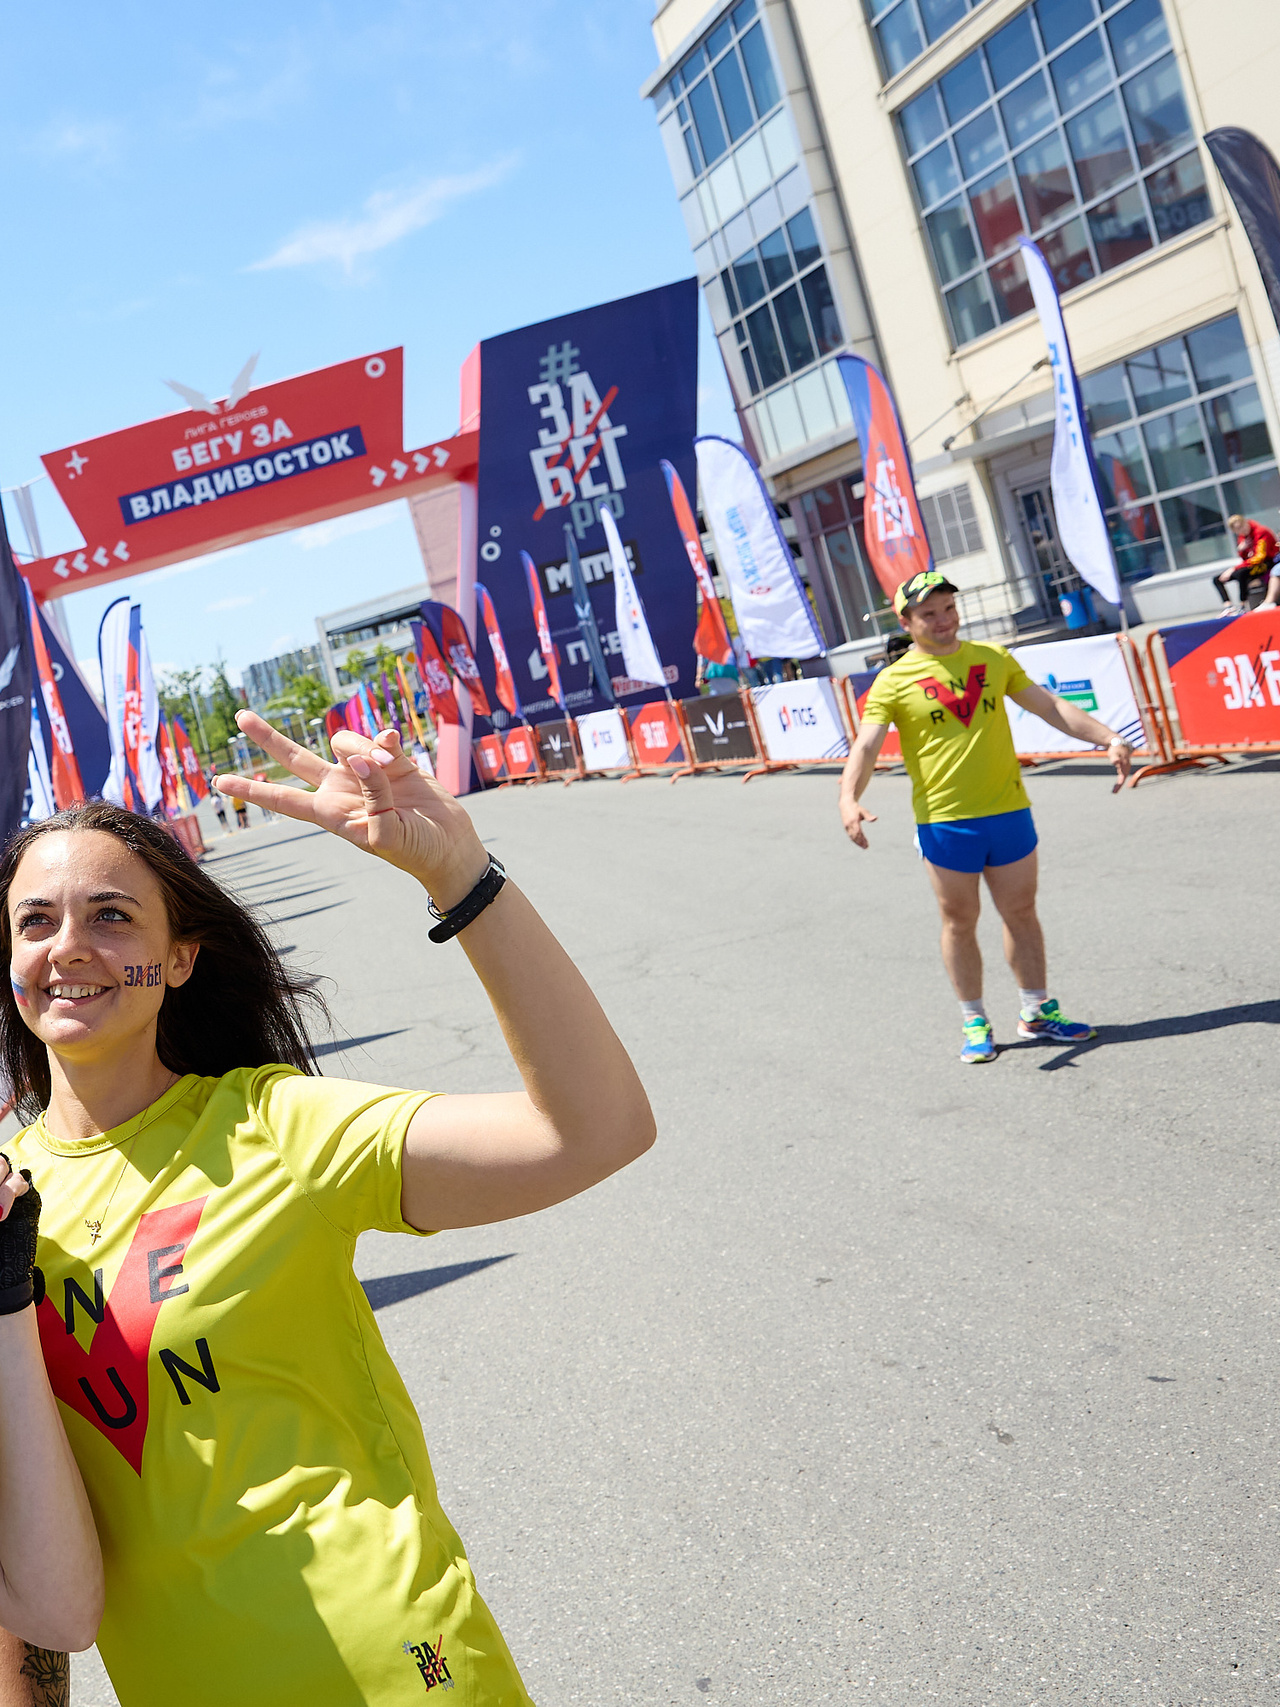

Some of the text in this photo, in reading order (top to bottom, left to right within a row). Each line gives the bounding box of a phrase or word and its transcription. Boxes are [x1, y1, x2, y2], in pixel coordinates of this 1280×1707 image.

[184, 405, 269, 440] ЛИГА ГЕРОЕВ
[527, 371, 613, 447] ЗА
[171, 418, 294, 472] БЕГУ ЗА
[529, 424, 628, 510] БЕГ
[129, 433, 354, 520] ВЛАДИВОСТОК
[924, 673, 990, 700] ONE
[930, 698, 996, 724] RUN
